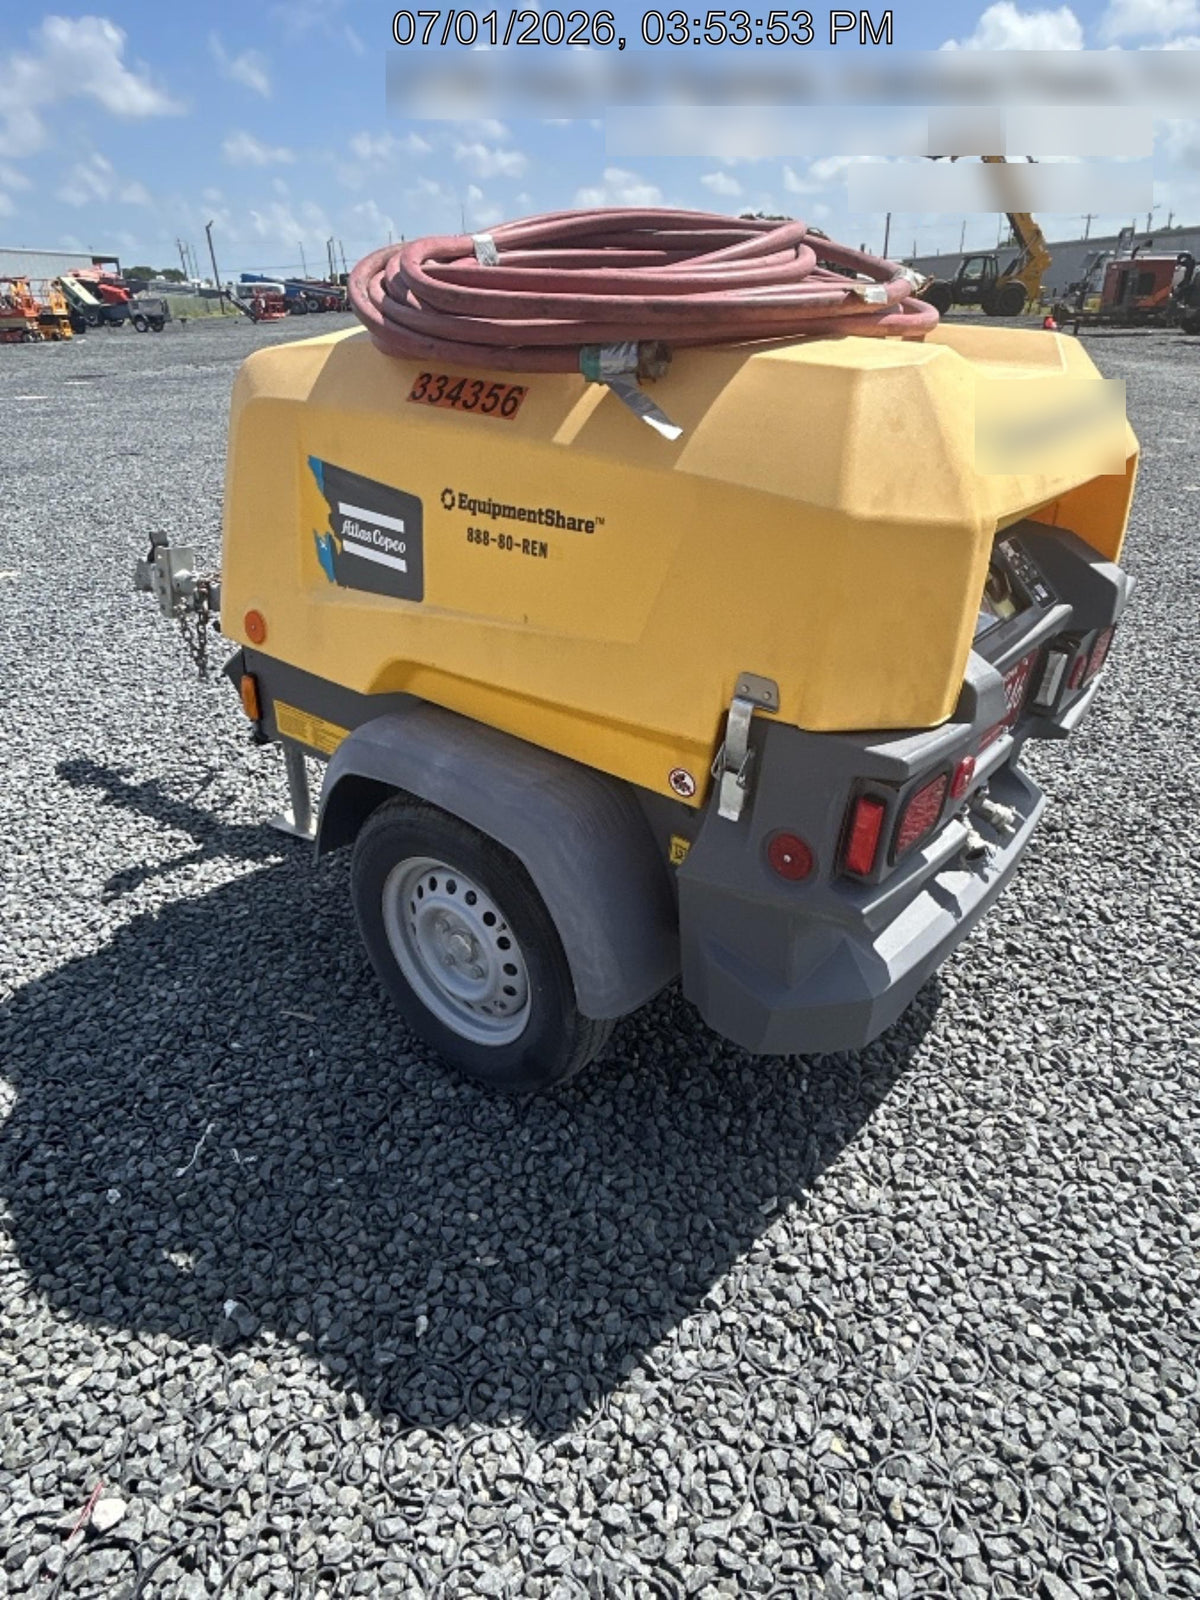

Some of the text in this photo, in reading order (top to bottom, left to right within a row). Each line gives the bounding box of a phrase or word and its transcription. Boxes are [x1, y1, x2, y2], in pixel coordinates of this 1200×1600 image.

[410, 372, 524, 417] 334356
[341, 520, 406, 553] Atlas Copco
[466, 526, 549, 559] 888-80-REN
